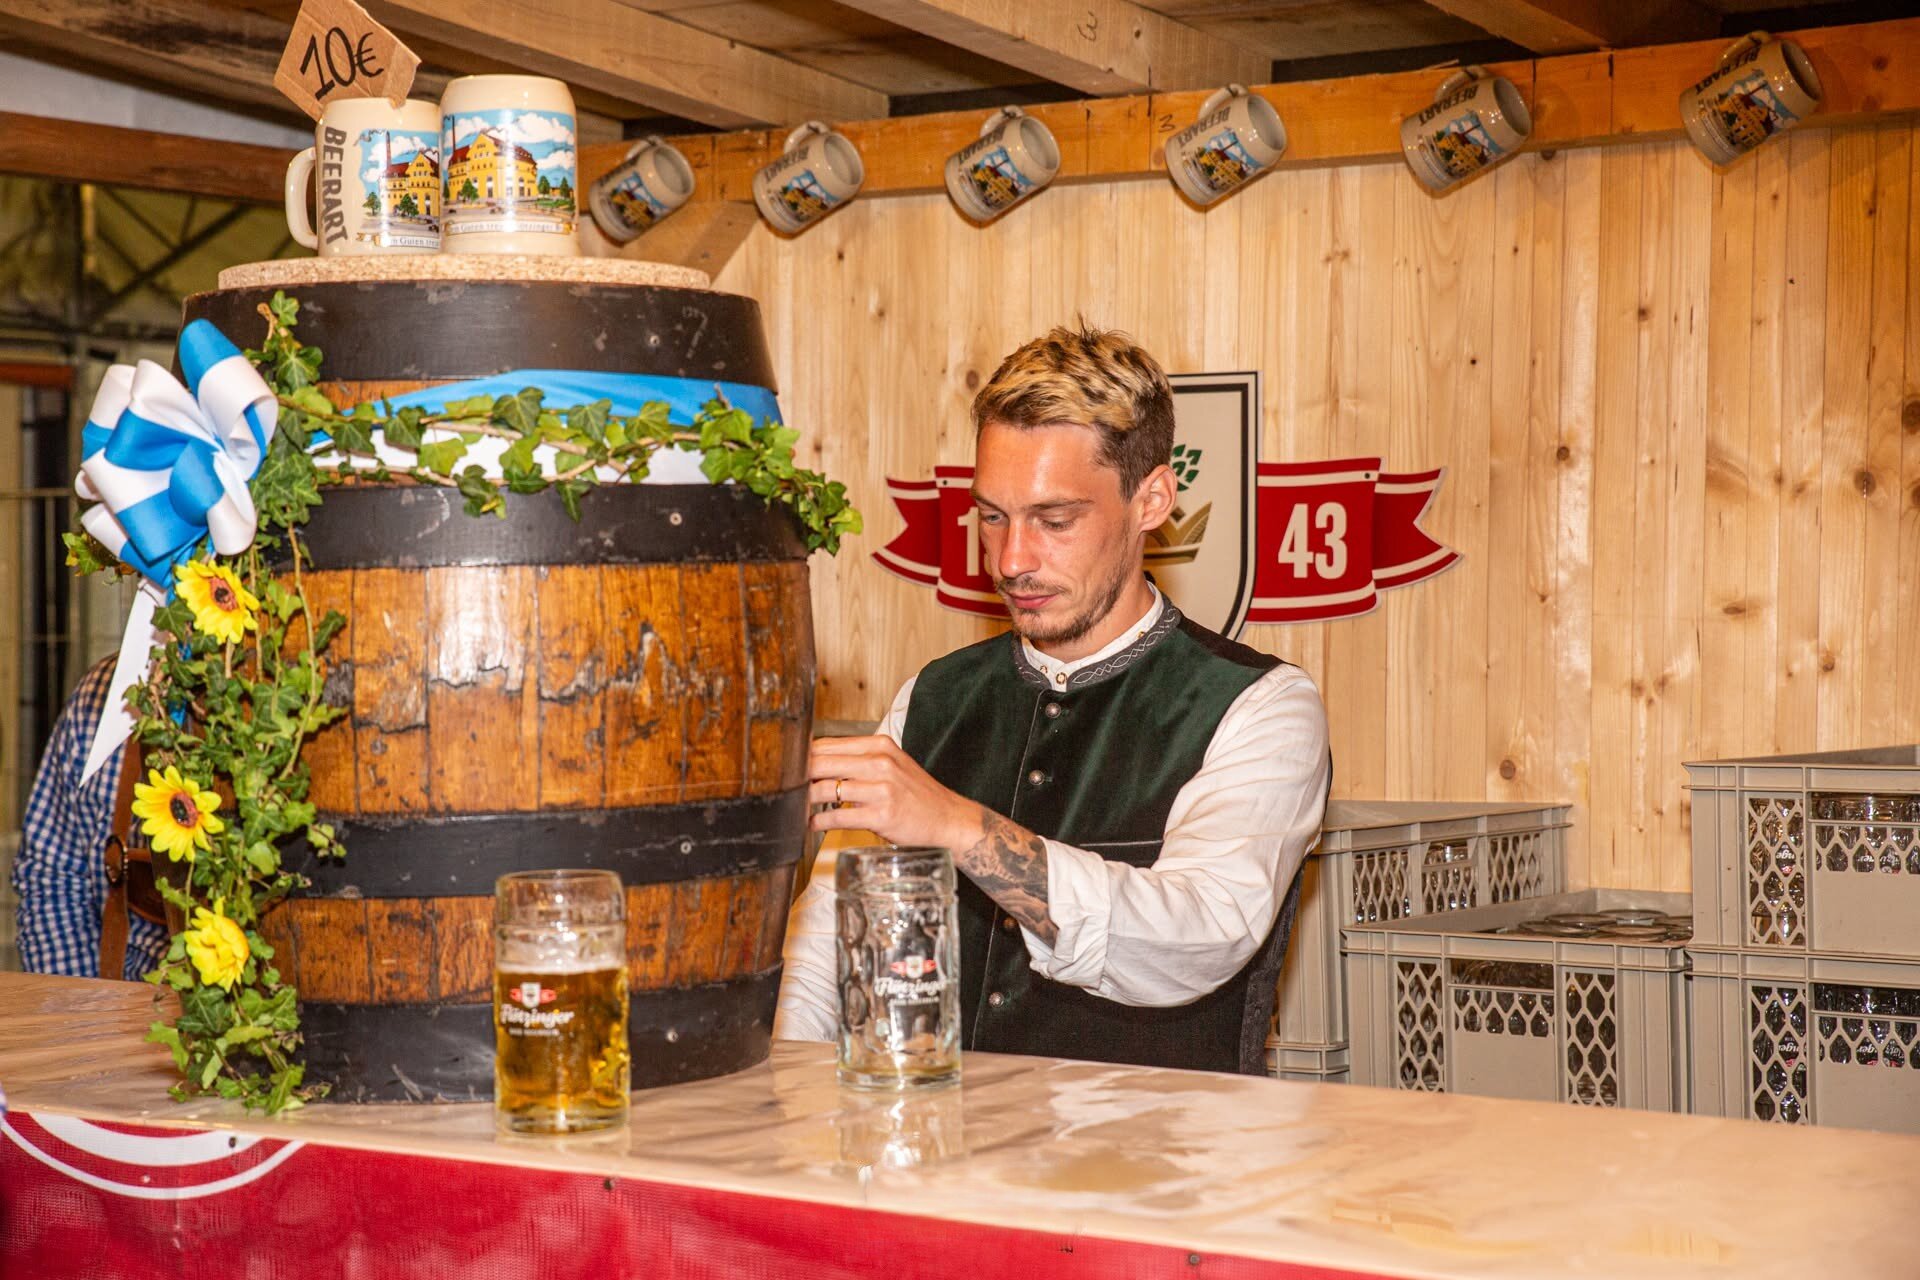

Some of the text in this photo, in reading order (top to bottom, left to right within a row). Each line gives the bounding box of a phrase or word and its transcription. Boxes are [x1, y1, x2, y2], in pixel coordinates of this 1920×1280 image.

[299, 26, 385, 101] 10€
[1176, 105, 1232, 147] BEERART
[1417, 84, 1480, 127] BEERART
[321, 125, 349, 245] BEERART
[957, 506, 993, 577] 1
[1277, 501, 1348, 580] 43
